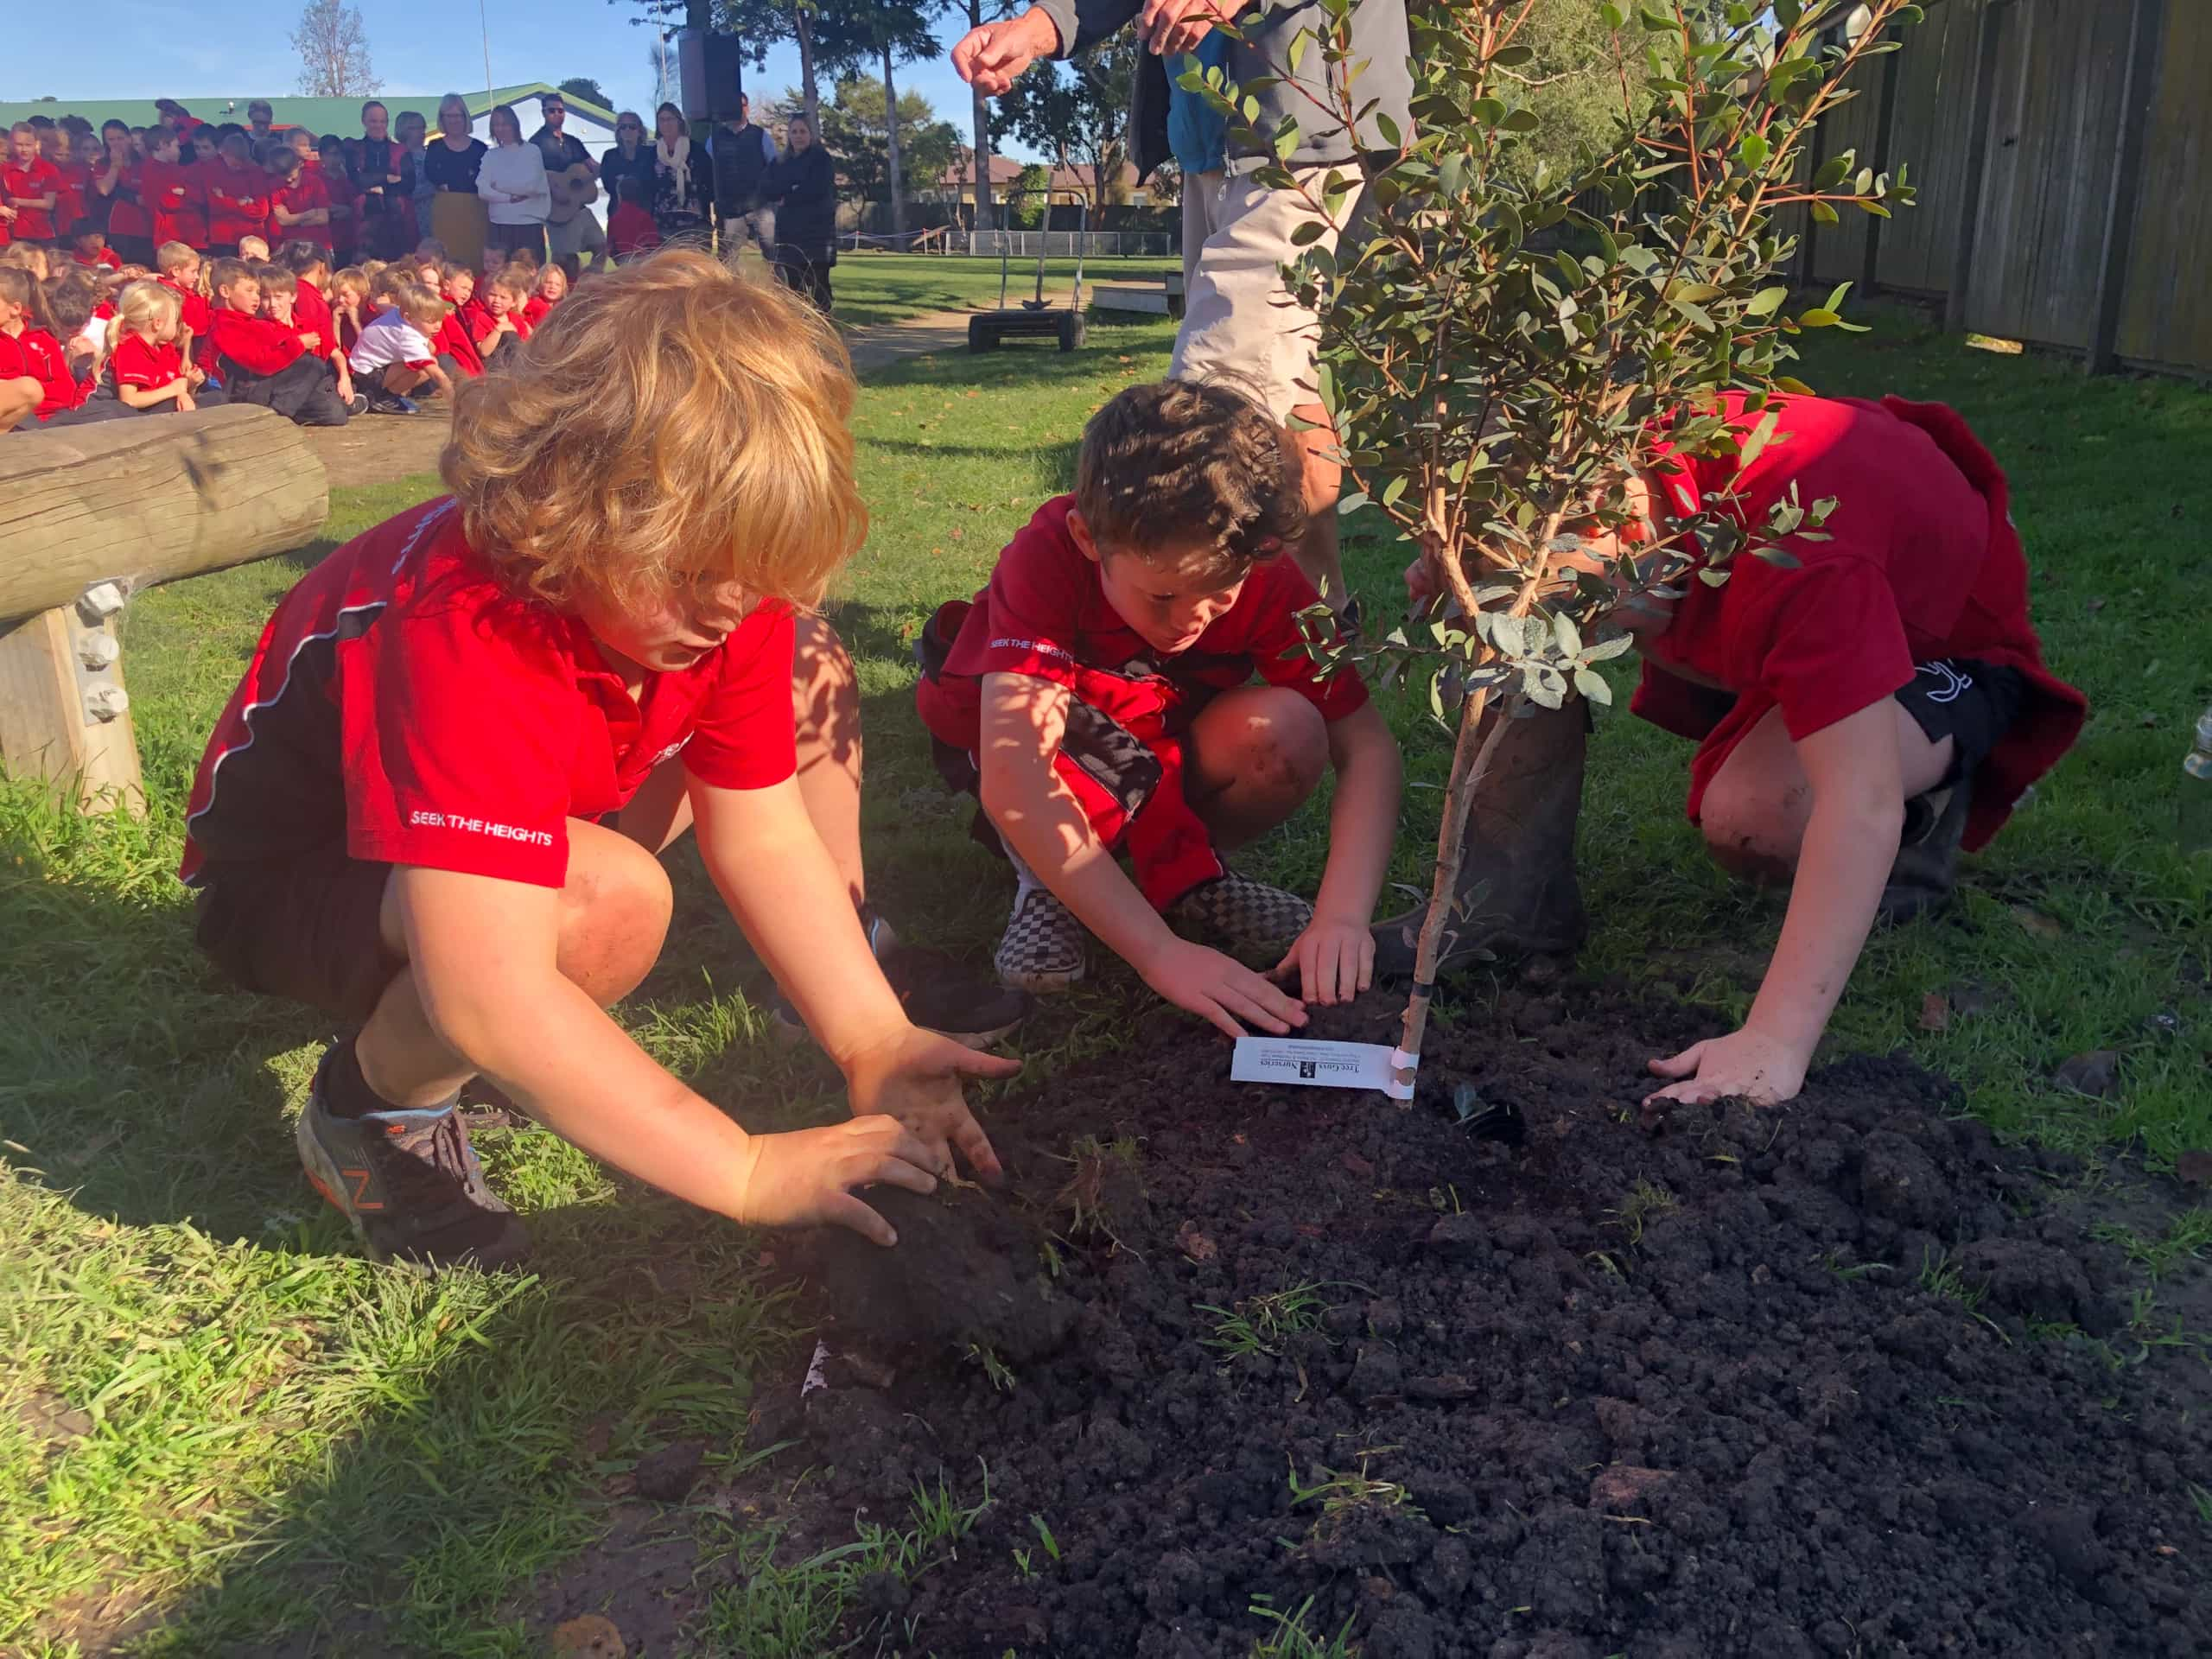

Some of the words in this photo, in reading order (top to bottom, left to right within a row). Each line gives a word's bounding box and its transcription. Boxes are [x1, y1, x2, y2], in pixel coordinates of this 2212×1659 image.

[1010, 639, 1031, 649] THE
[410, 810, 446, 827] SEEK
[448, 814, 484, 832] THE
[485, 822, 553, 846] HEIGHTS
[1260, 1059, 1298, 1071] Nurseries
[1341, 1064, 1360, 1073] Tree
